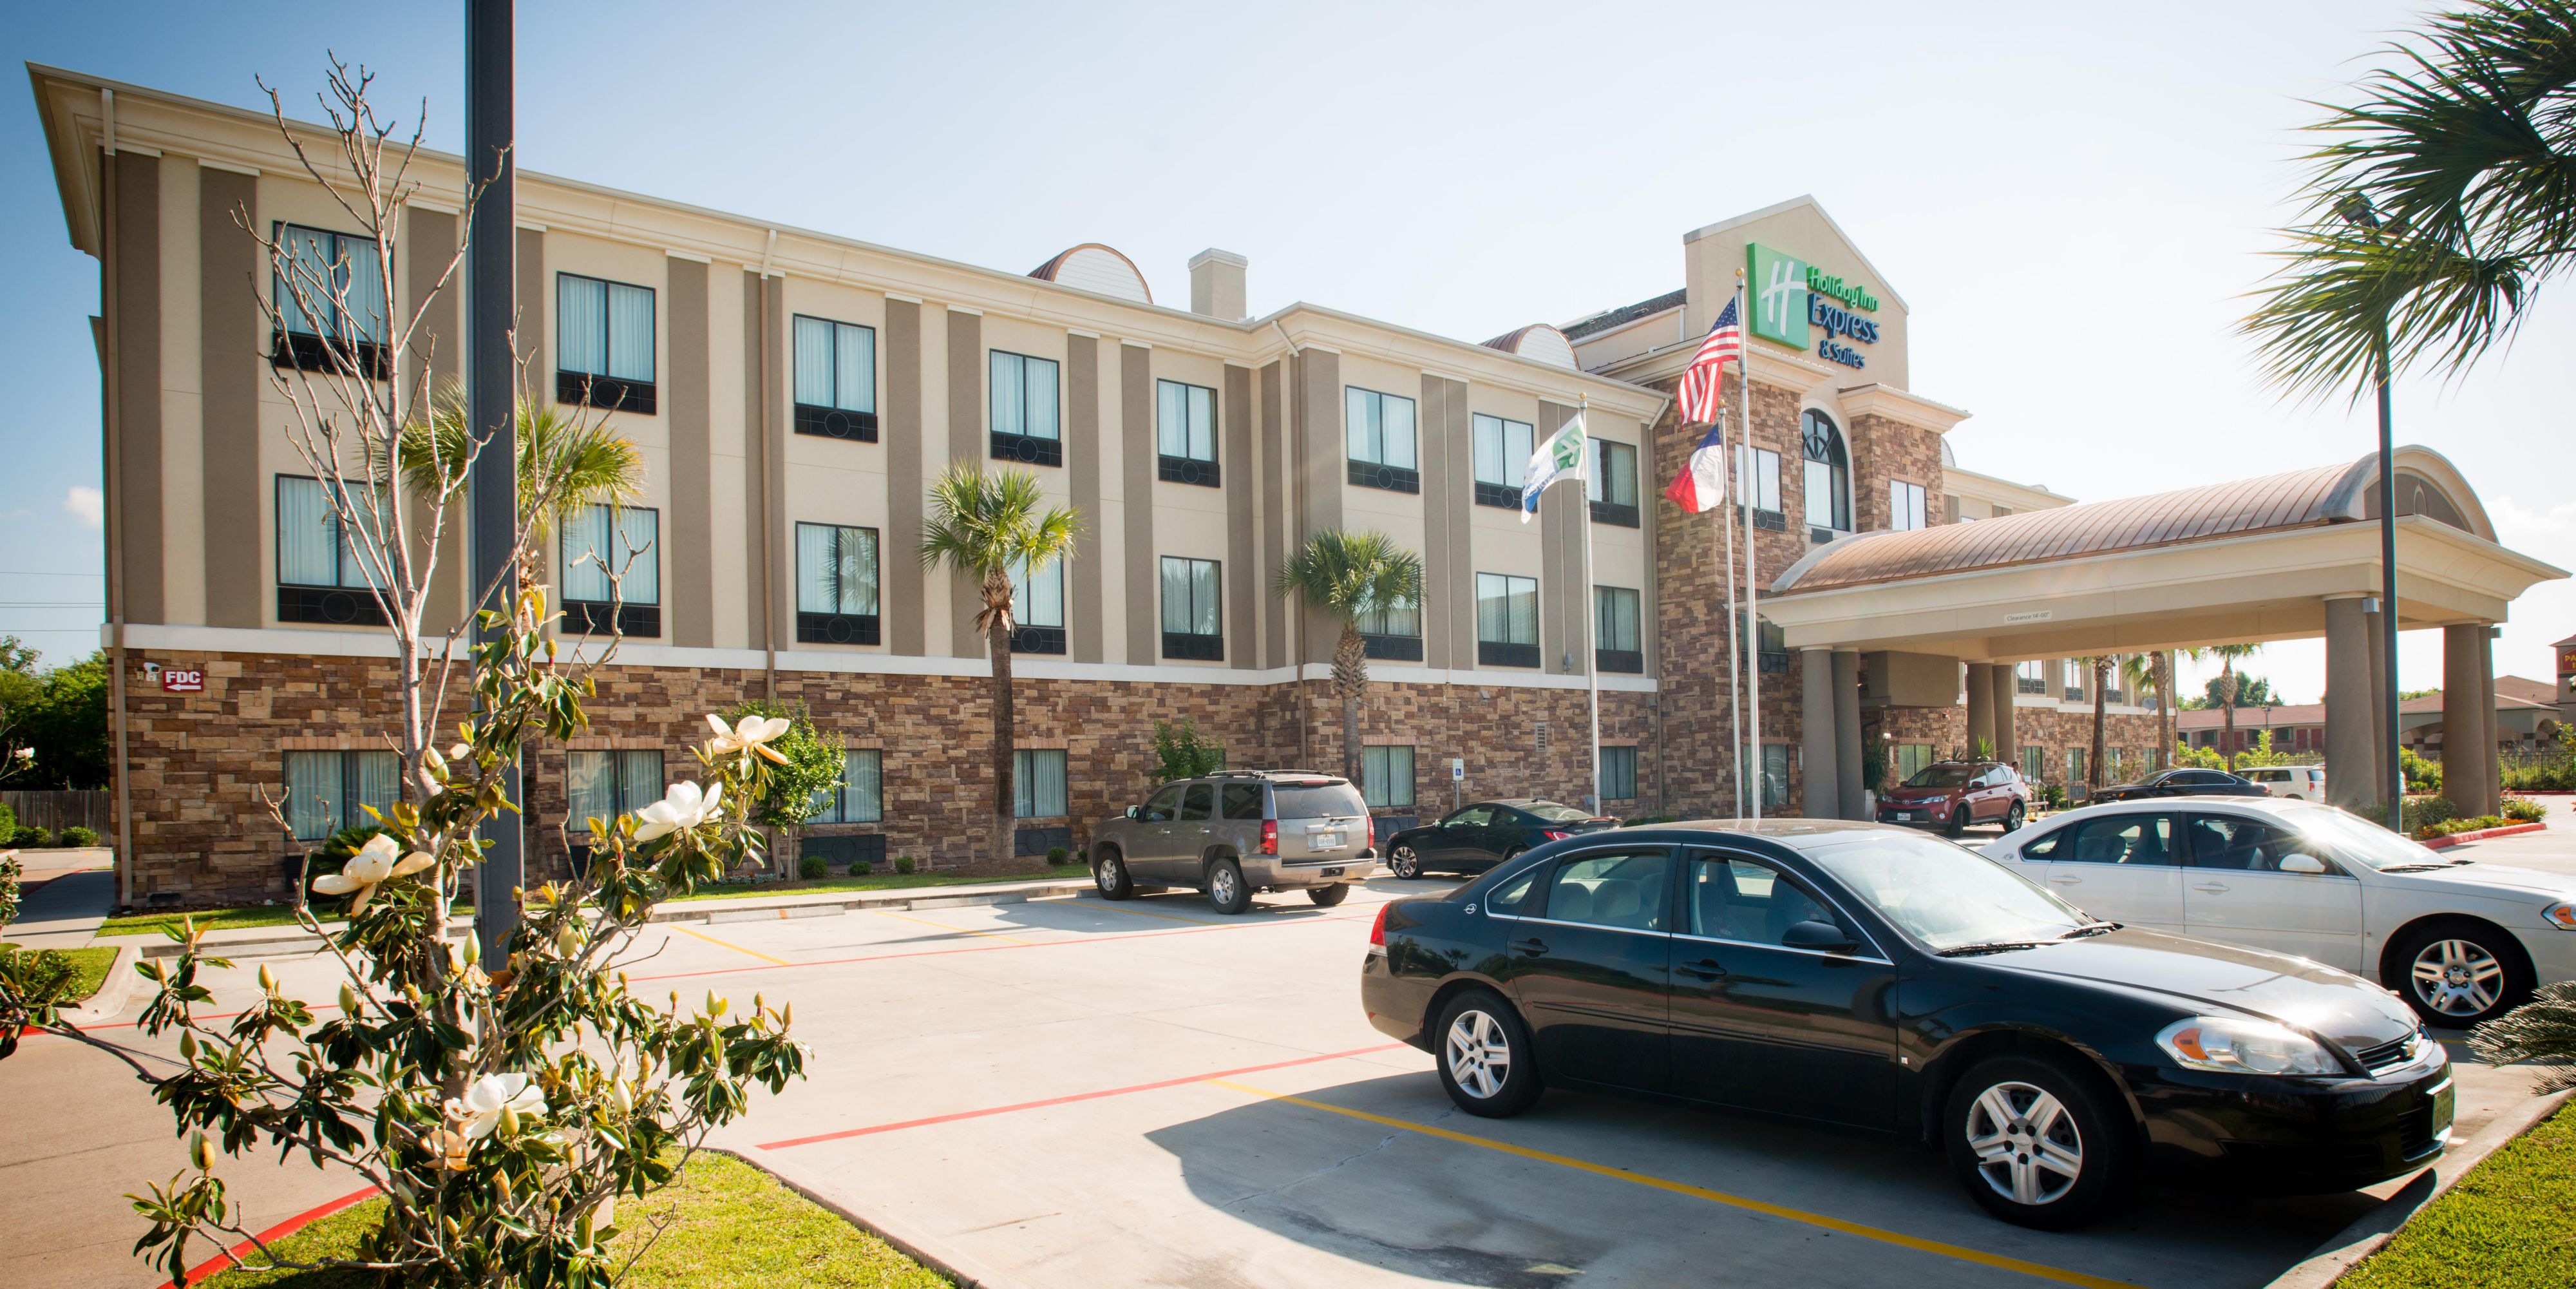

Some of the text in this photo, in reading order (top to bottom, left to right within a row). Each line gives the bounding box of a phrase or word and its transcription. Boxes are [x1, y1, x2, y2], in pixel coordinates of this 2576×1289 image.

[1807, 266, 1879, 312] Holiday Inn
[1807, 293, 1879, 344] Express
[1819, 339, 1865, 369] & Suites
[166, 671, 201, 683] FDC
